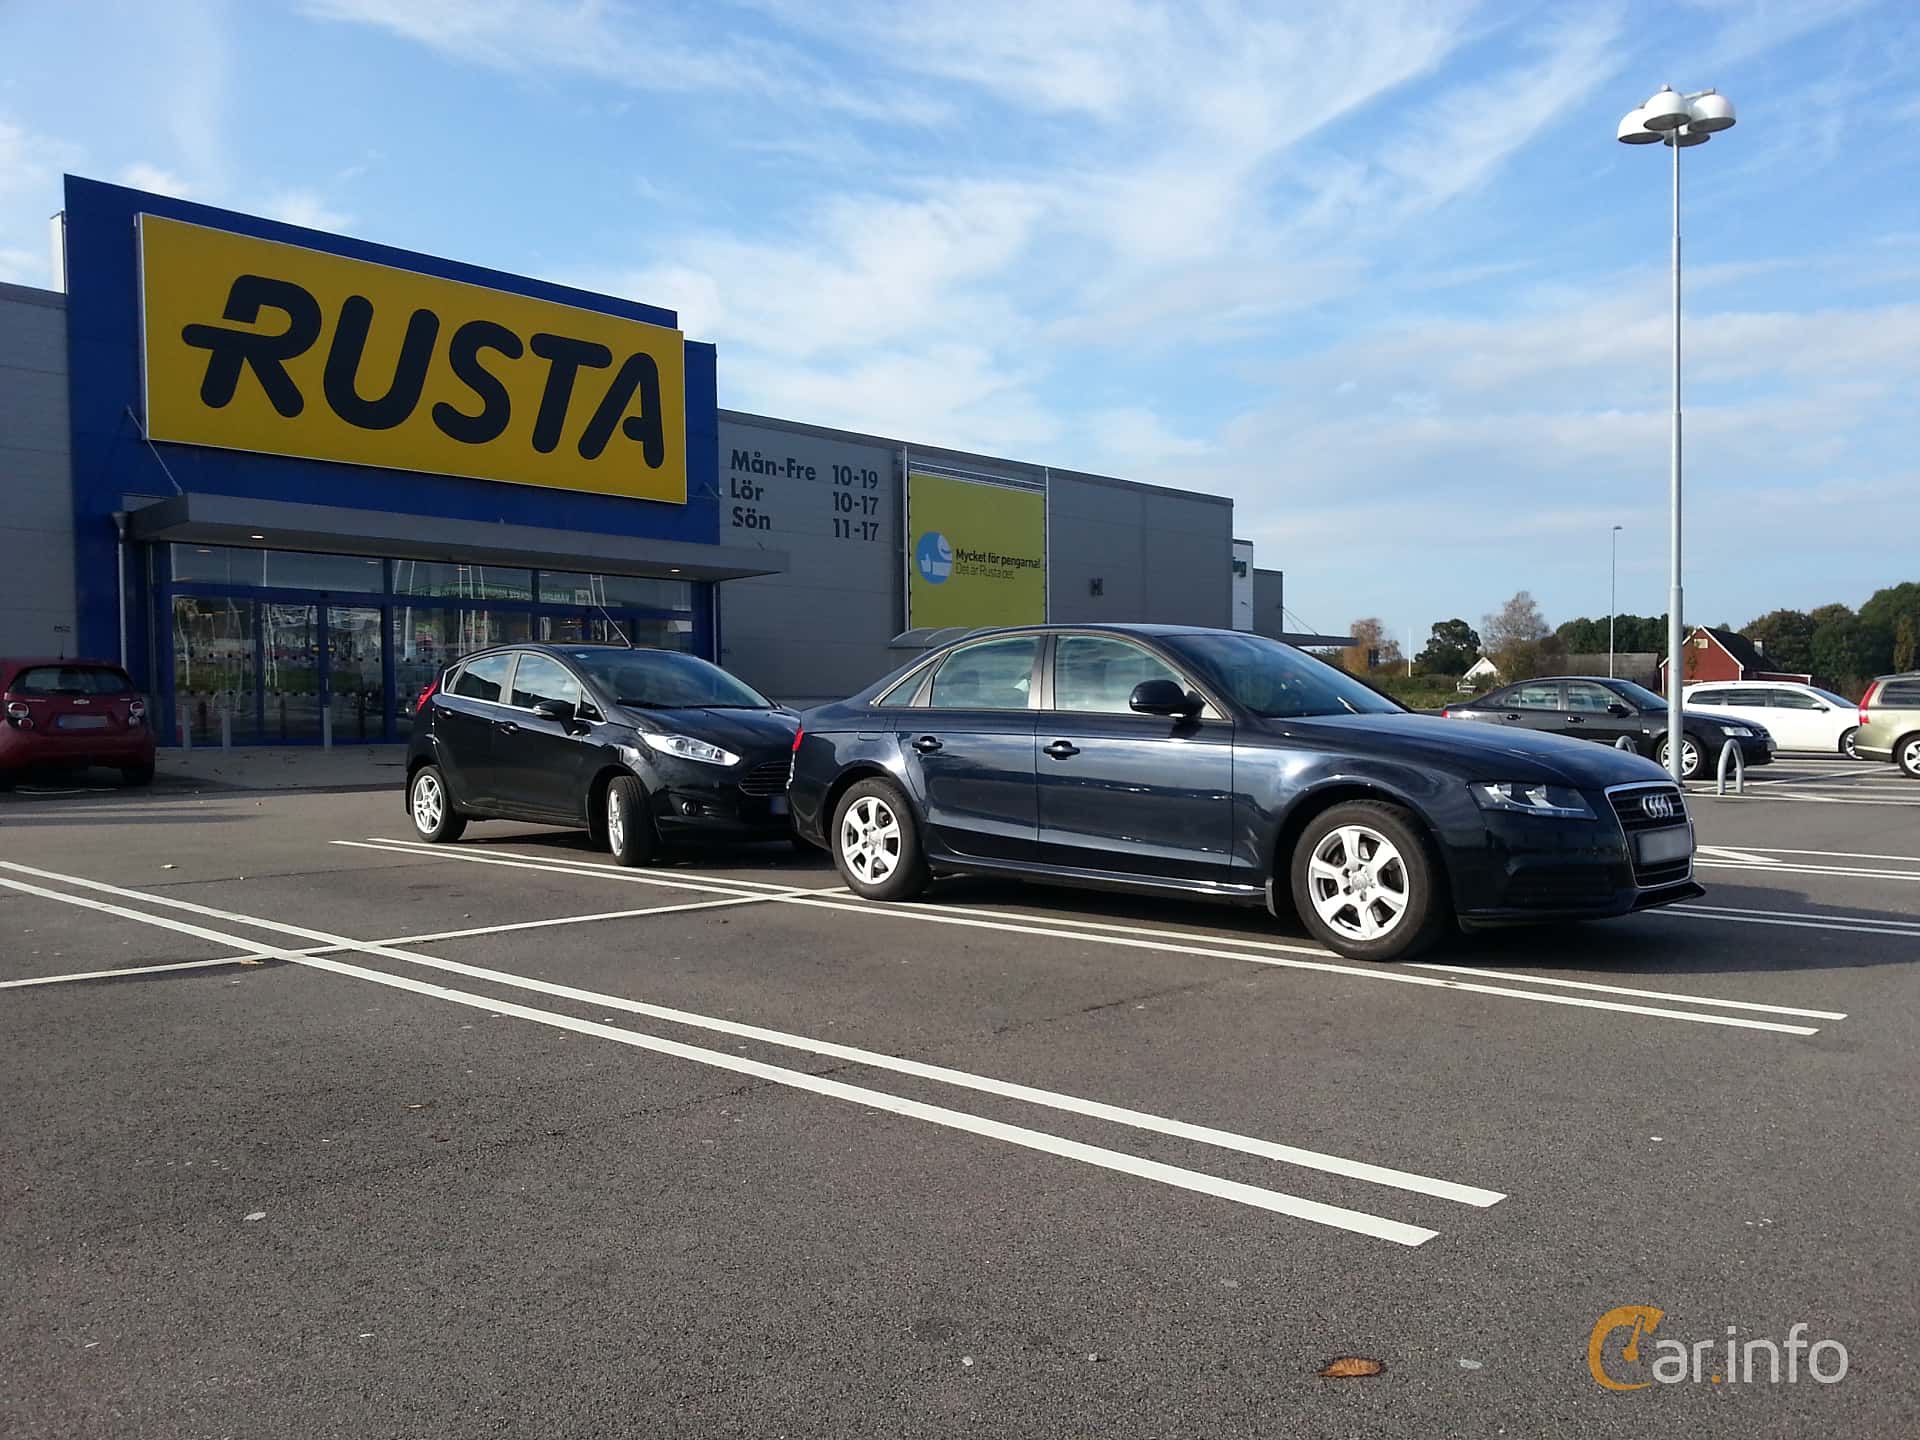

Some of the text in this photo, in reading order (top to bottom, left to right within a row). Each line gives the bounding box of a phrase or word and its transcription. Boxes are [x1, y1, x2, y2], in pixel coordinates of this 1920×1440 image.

[181, 274, 664, 469] RUSTA
[731, 449, 878, 489] Mån-Fre 10-19
[731, 477, 879, 515] Lör 10-17
[732, 506, 879, 541] Sön 11-17
[956, 548, 986, 563] Mycket
[988, 552, 1000, 563] för
